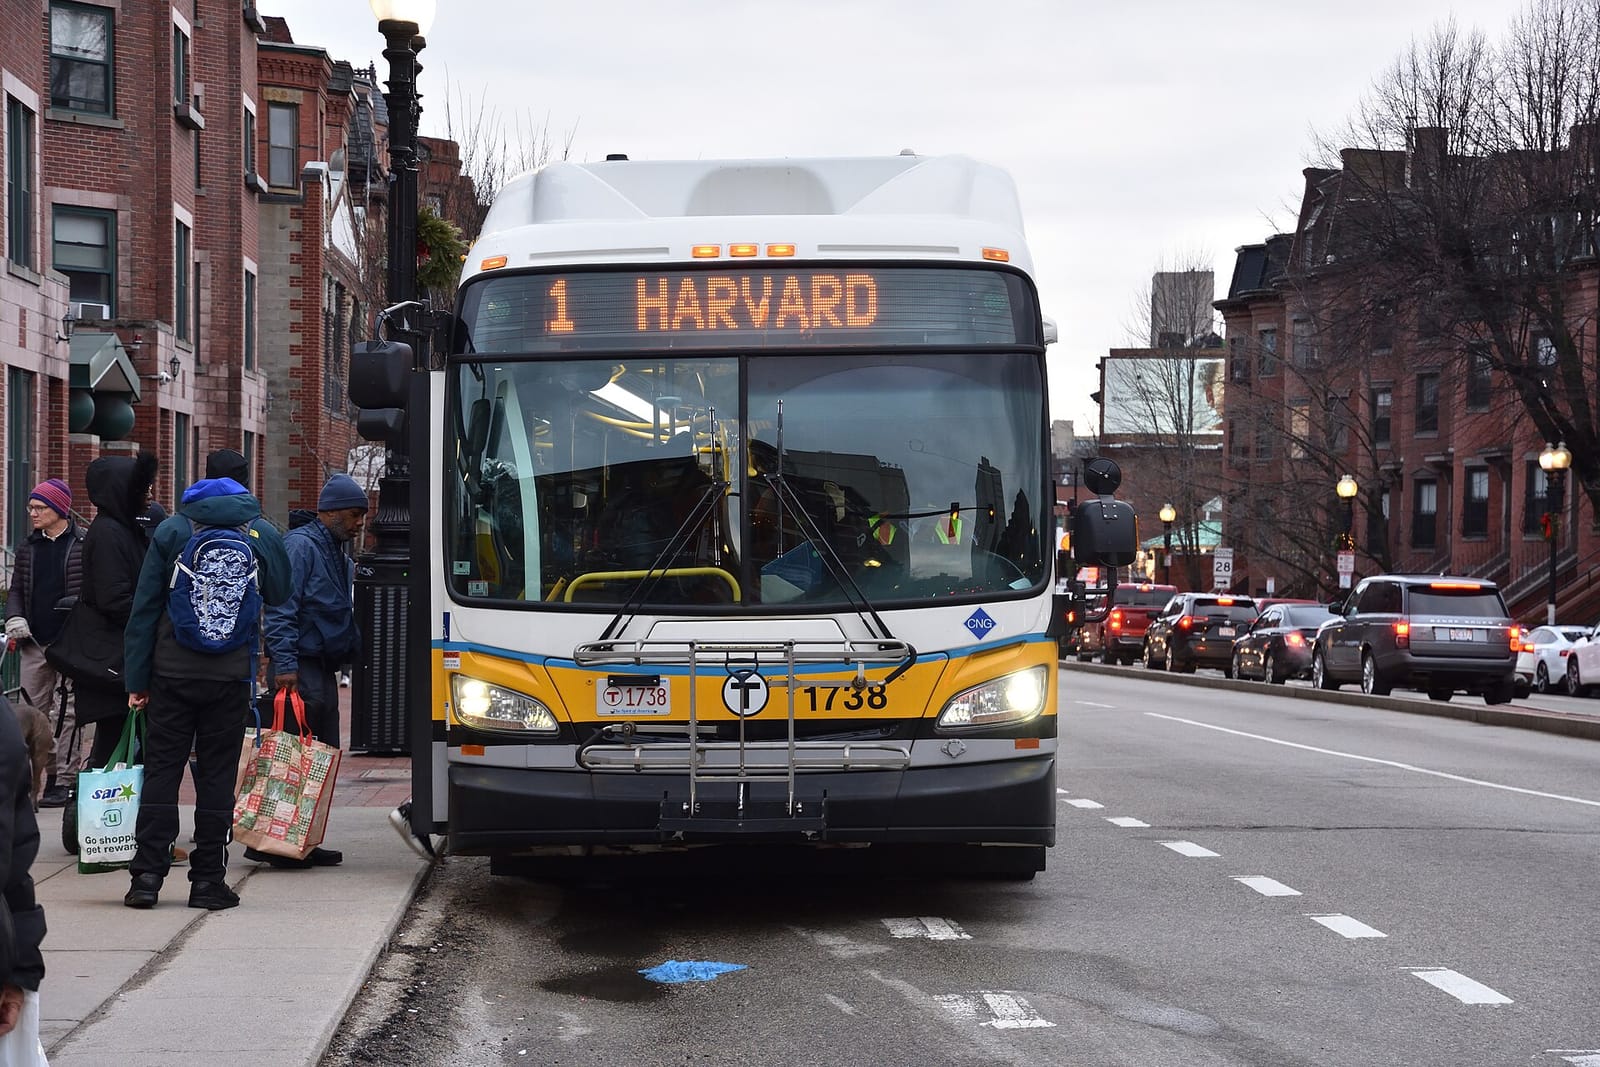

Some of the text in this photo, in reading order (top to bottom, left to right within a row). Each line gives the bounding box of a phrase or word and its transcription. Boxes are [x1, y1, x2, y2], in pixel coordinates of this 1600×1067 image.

[549, 274, 878, 331] 1 HARVARD
[1215, 561, 1231, 573] 28
[967, 618, 992, 629] CNG
[626, 687, 667, 706] 1738
[803, 683, 888, 712] 1738
[85, 833, 134, 845] Go shoppi
[86, 845, 101, 856] get
